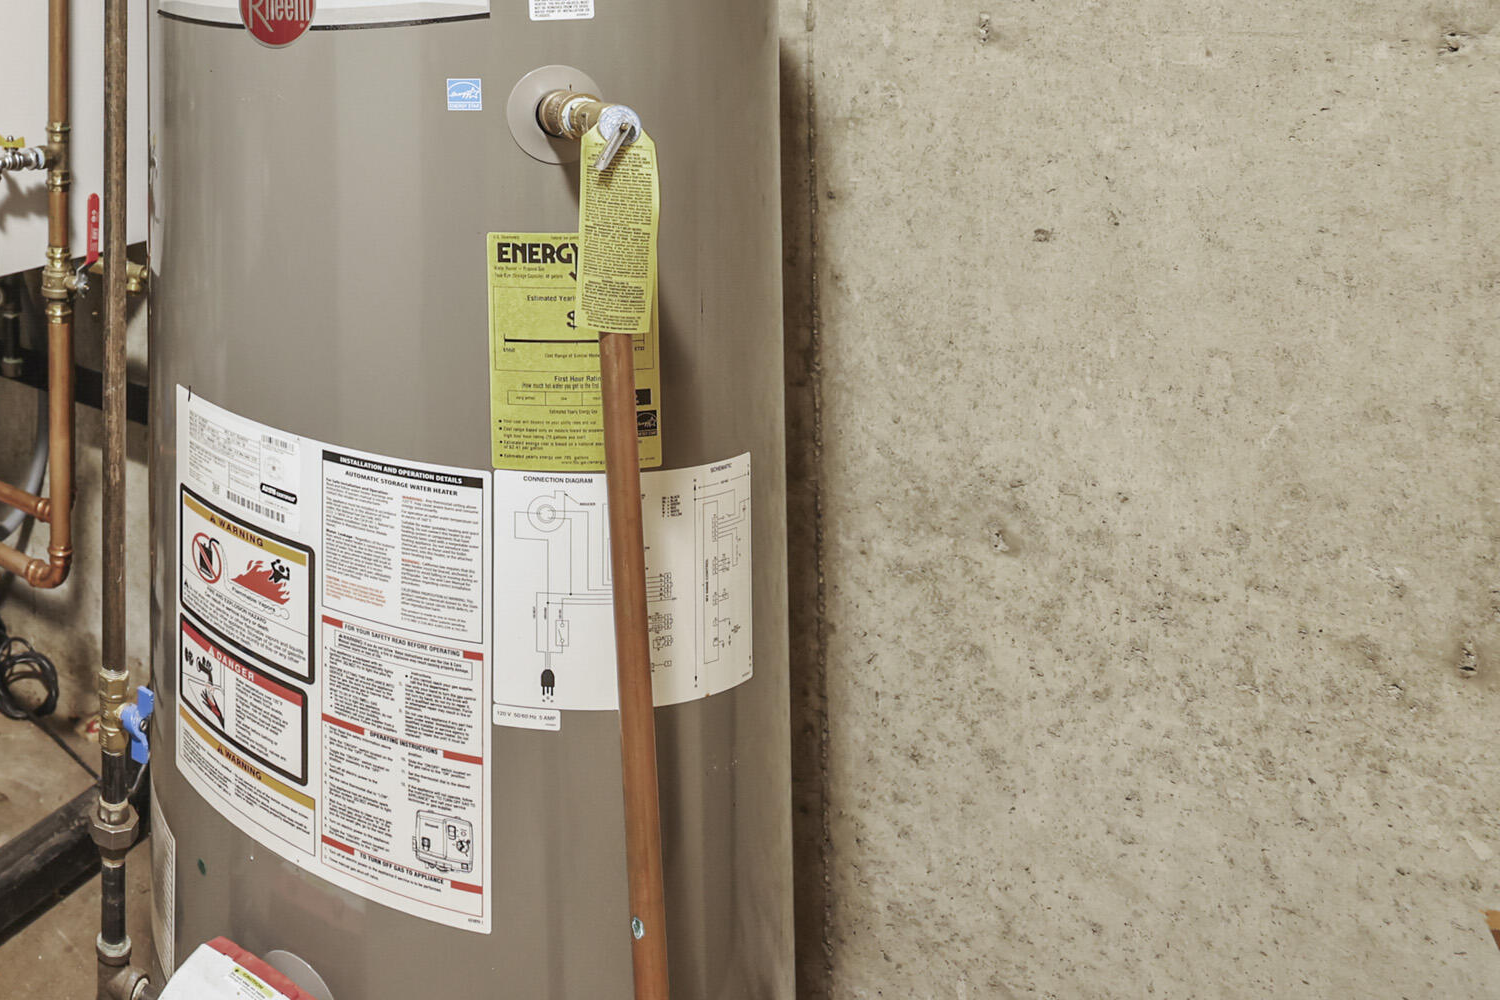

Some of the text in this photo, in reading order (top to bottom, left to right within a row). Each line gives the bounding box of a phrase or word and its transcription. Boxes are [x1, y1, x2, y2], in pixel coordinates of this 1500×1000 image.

[340, 457, 462, 485] INSTALLATION AND OPERATION DETAILS
[345, 471, 458, 496] AUTOMATIC STORAGE WATER HEATER
[523, 475, 593, 485] CONNECTION DIAGRAM
[219, 520, 264, 547] WARNING
[232, 587, 257, 603] Flammable
[344, 624, 460, 657] FOR YOUR SAFETY READ BEFORE OPERATING
[216, 652, 255, 682] DANGER
[370, 730, 438, 755] OPERATING INSTRUCTIONS
[225, 750, 262, 780] WARNING
[360, 852, 444, 884] TO TURN OFF GAS TO APPLIANCE
